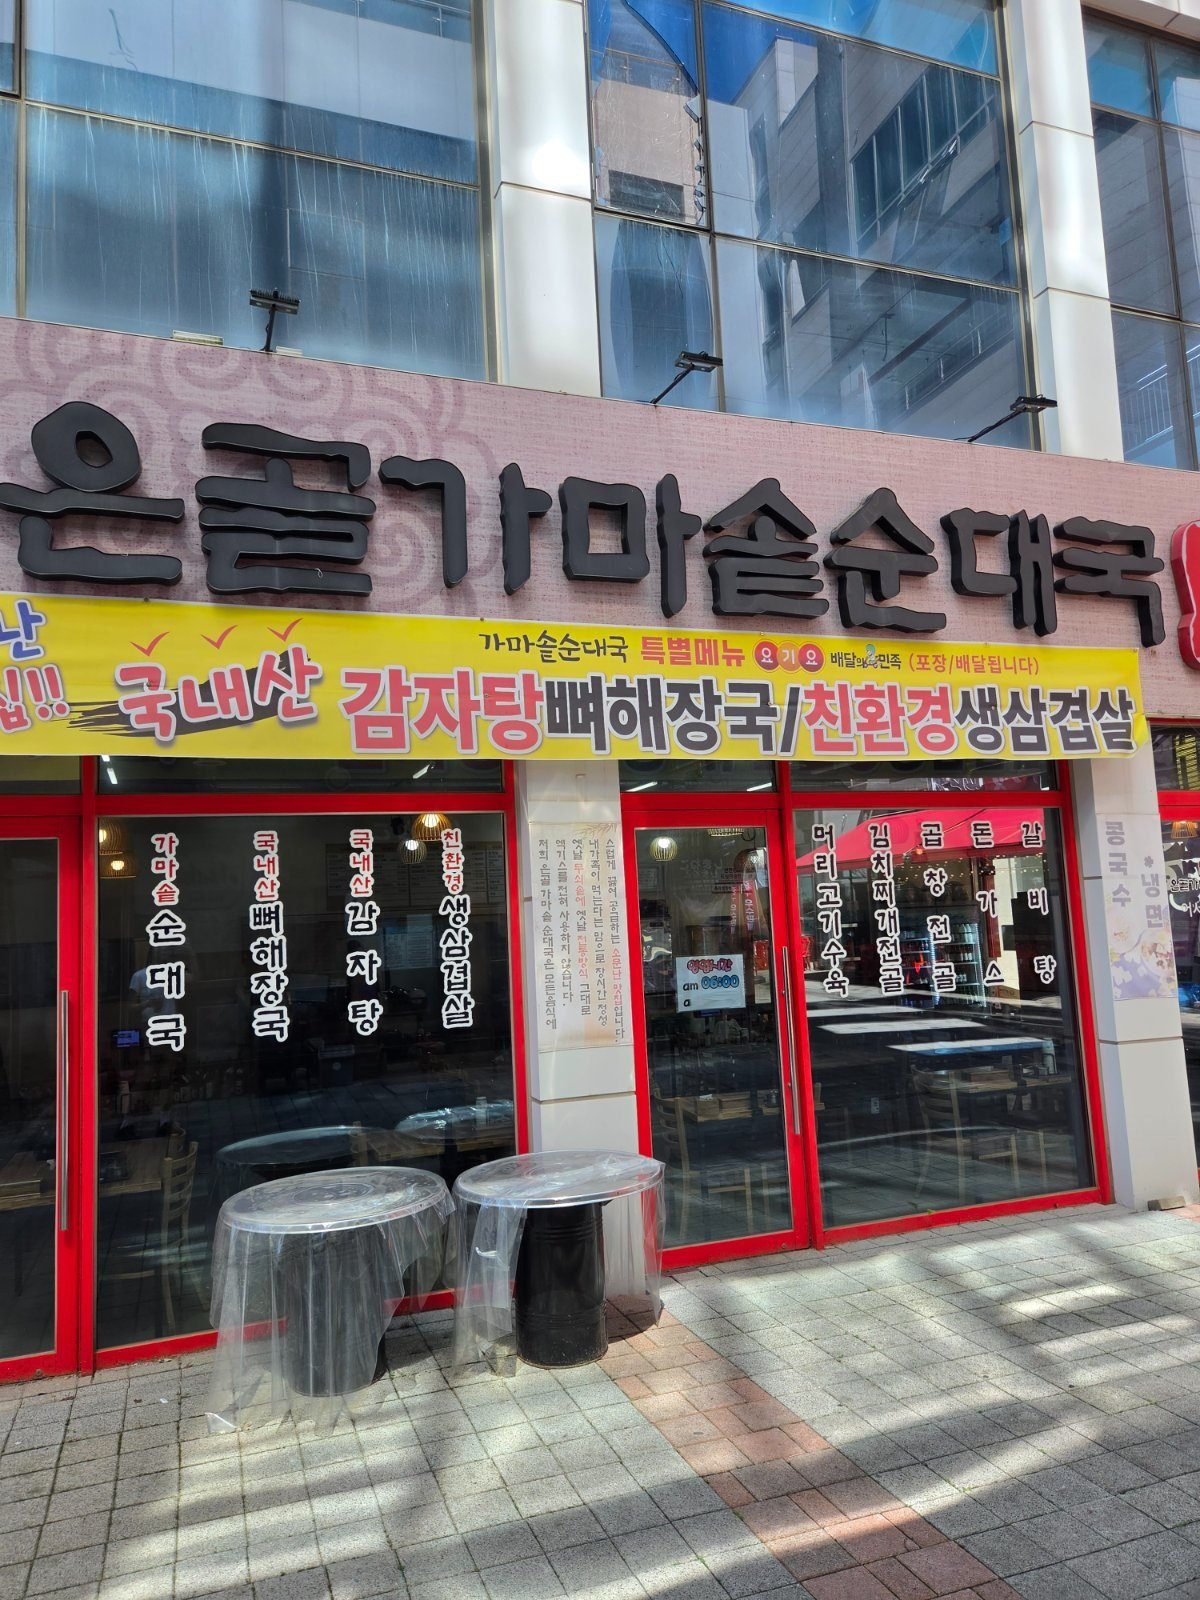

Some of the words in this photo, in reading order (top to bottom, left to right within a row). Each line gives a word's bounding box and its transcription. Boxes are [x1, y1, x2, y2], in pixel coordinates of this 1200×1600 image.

[115, 645, 323, 743] 국내산
[479, 630, 629, 663] 가마솥순대국
[641, 636, 746, 667] 특별메뉴
[758, 644, 821, 668] 요기요
[909, 652, 1040, 675] (포장/배달됩니다)
[812, 823, 850, 998] 머리고기수육
[920, 822, 957, 993] 곱창전골
[971, 822, 1005, 987] 돈가스
[1021, 822, 1057, 984] 갈비탕
[1105, 820, 1131, 908] 콩국수
[1141, 873, 1163, 929] 냉면
[683, 982, 699, 991] am
[701, 975, 740, 990] 06:00
